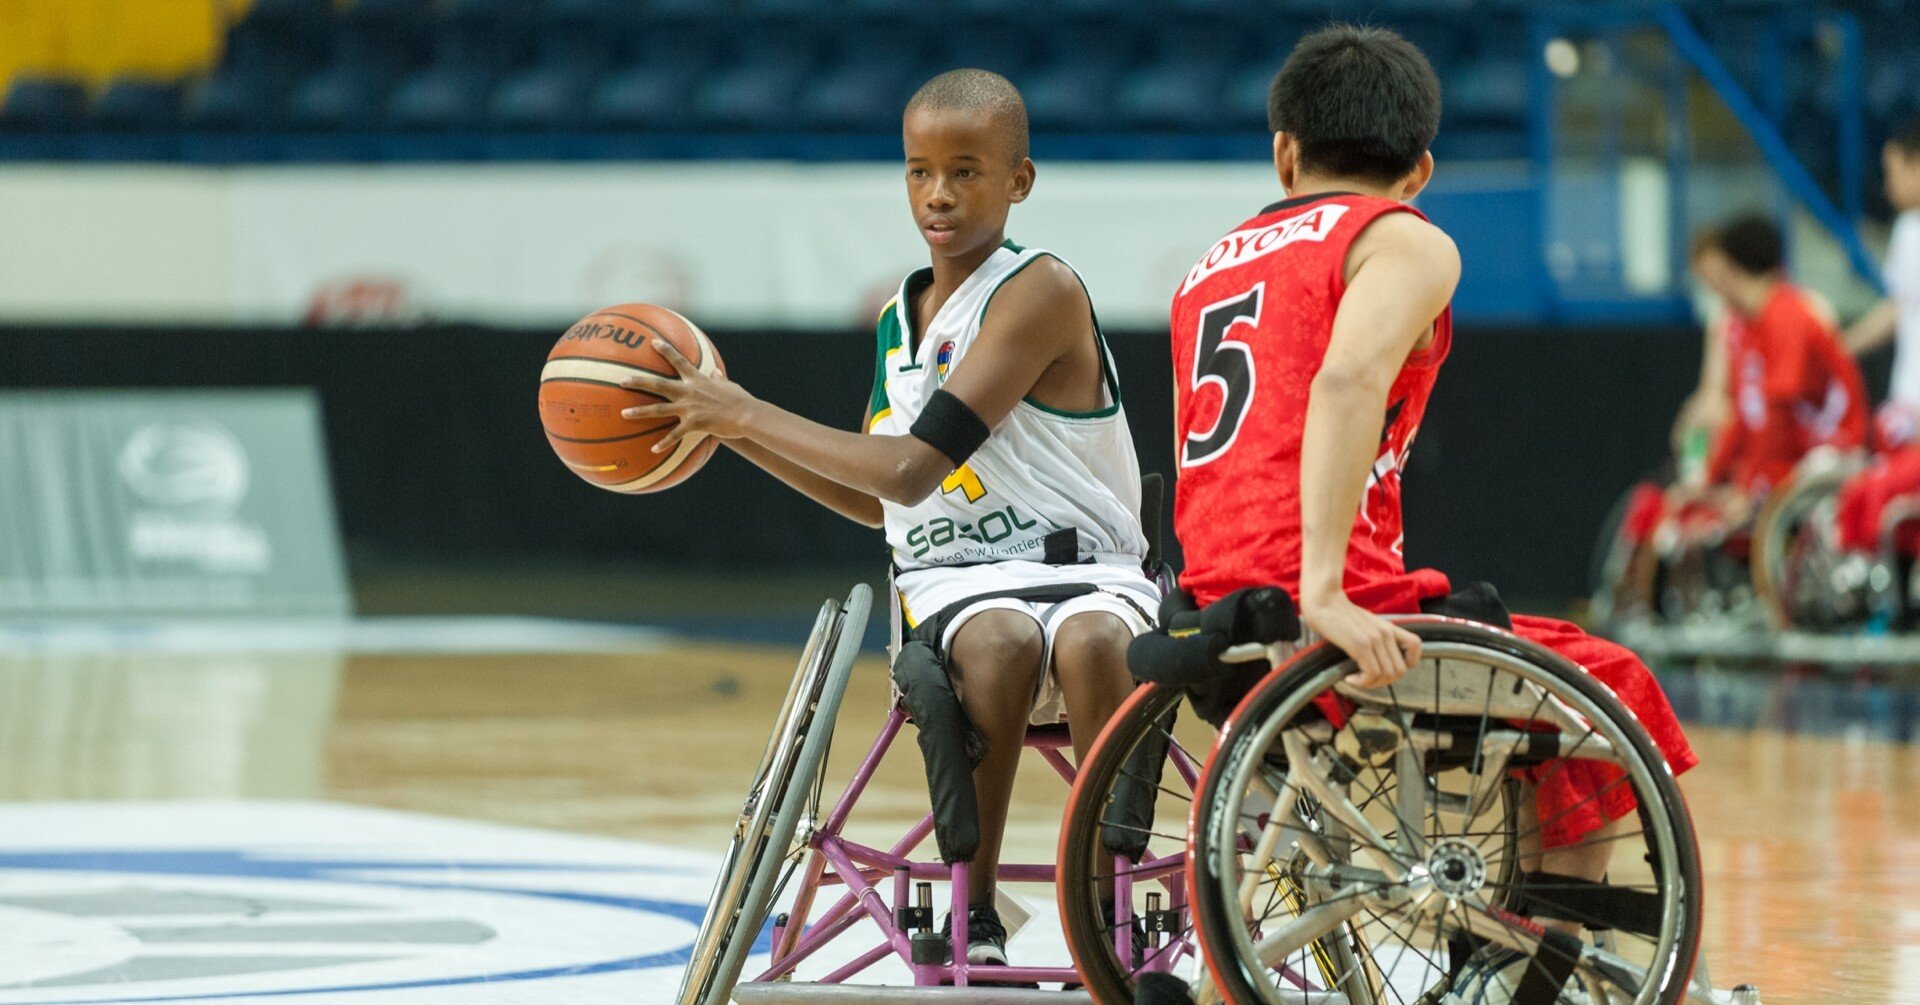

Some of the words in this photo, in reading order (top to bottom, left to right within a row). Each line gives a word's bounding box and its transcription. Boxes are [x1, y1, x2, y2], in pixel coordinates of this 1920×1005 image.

[1191, 209, 1324, 281] TOYOTA
[557, 322, 646, 349] molte
[1181, 281, 1265, 468] 5
